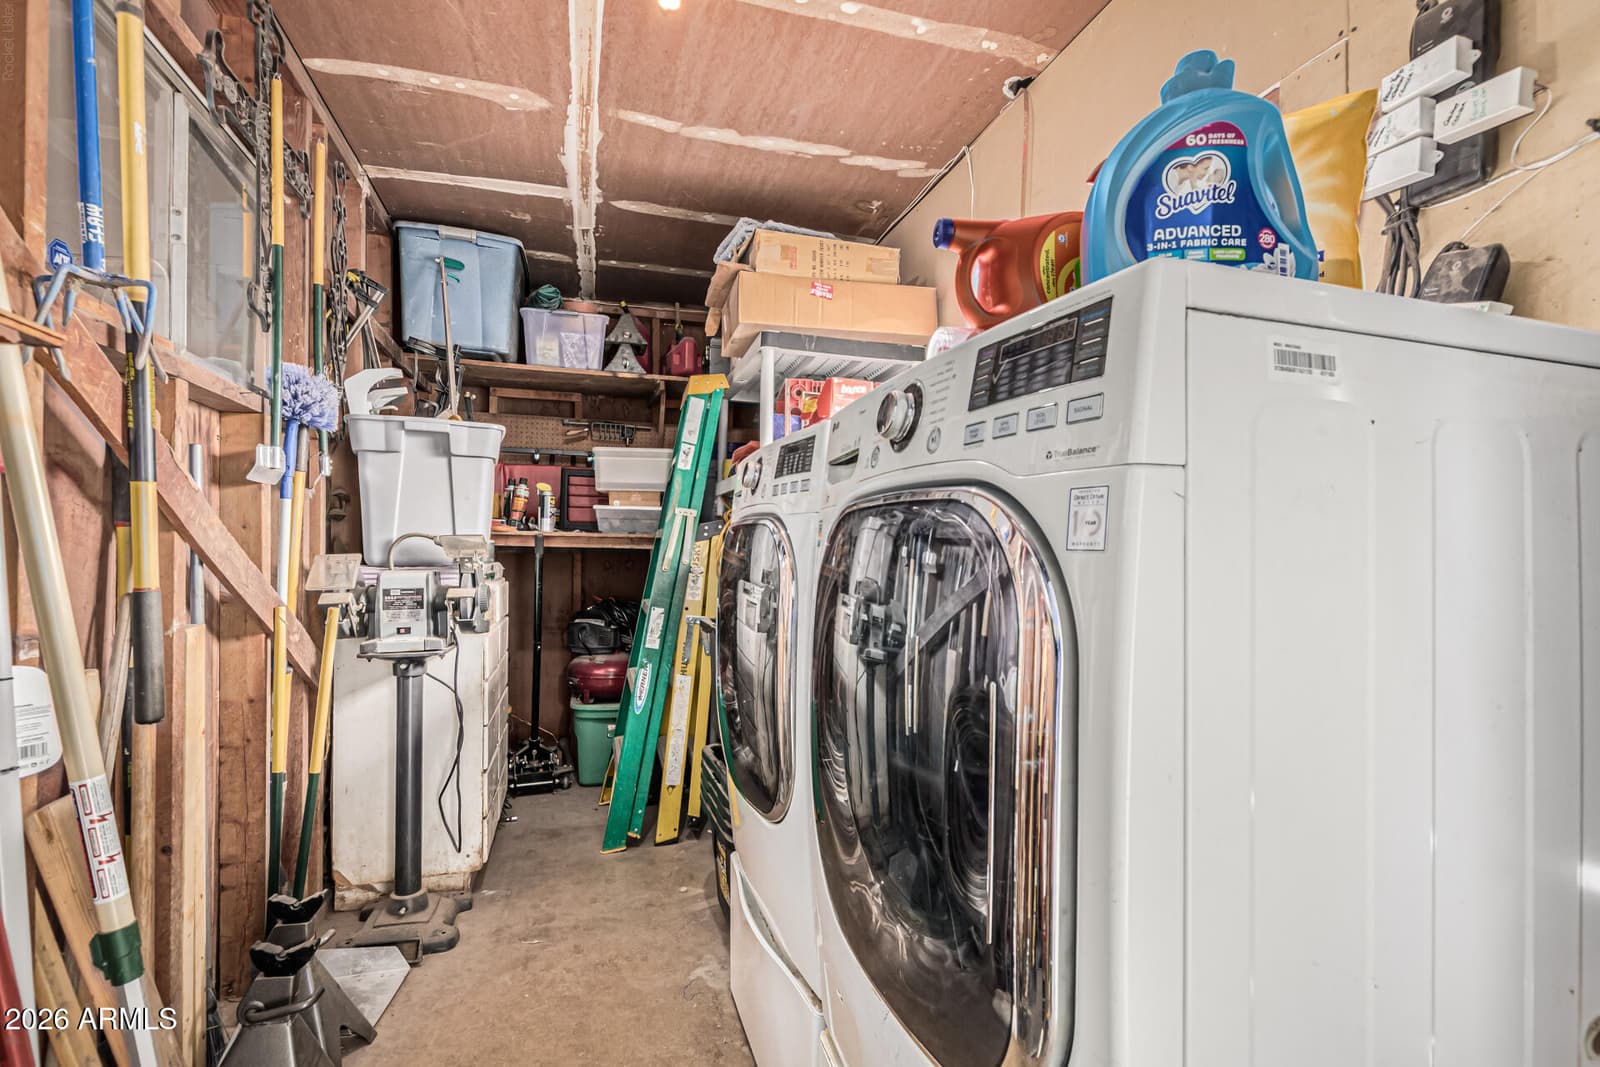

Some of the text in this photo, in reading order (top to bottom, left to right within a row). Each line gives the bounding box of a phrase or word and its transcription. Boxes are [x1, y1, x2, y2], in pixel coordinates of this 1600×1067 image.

[1186, 134, 1207, 146] 60
[1156, 181, 1236, 218] Suavitel
[1153, 224, 1242, 242] ADVANCED
[1259, 234, 1275, 244] 280
[1146, 238, 1247, 252] 3-IN-1 FABRIC CARE
